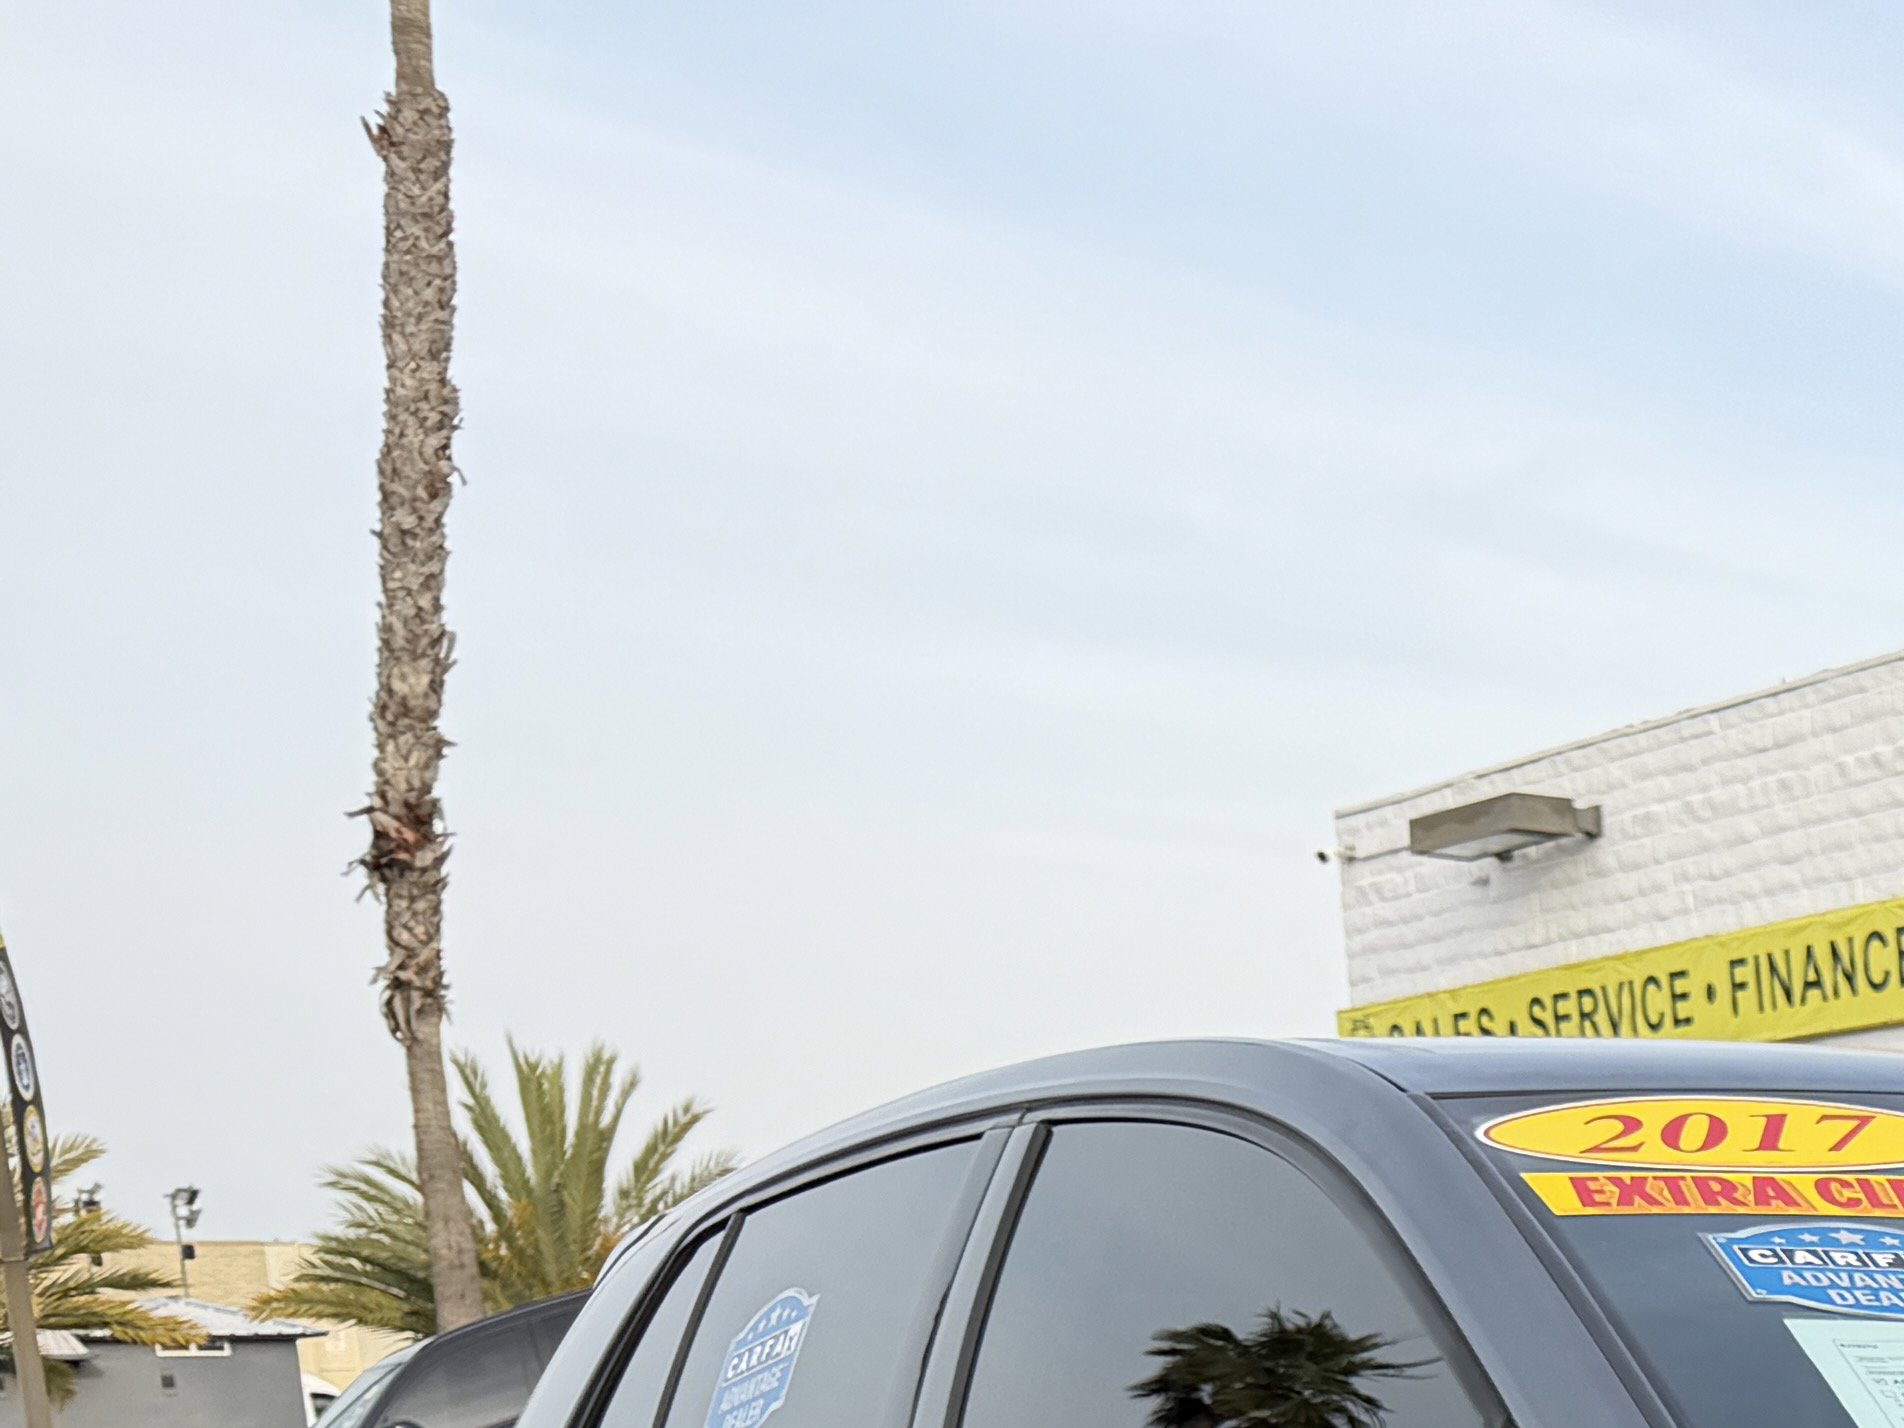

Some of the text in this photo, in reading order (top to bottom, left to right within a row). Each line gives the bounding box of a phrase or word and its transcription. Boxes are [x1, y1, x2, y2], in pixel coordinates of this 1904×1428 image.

[1528, 969, 1694, 1037] SERVICE
[1578, 1112, 1881, 1155] 2017
[1567, 1175, 1801, 1211] EXTRA
